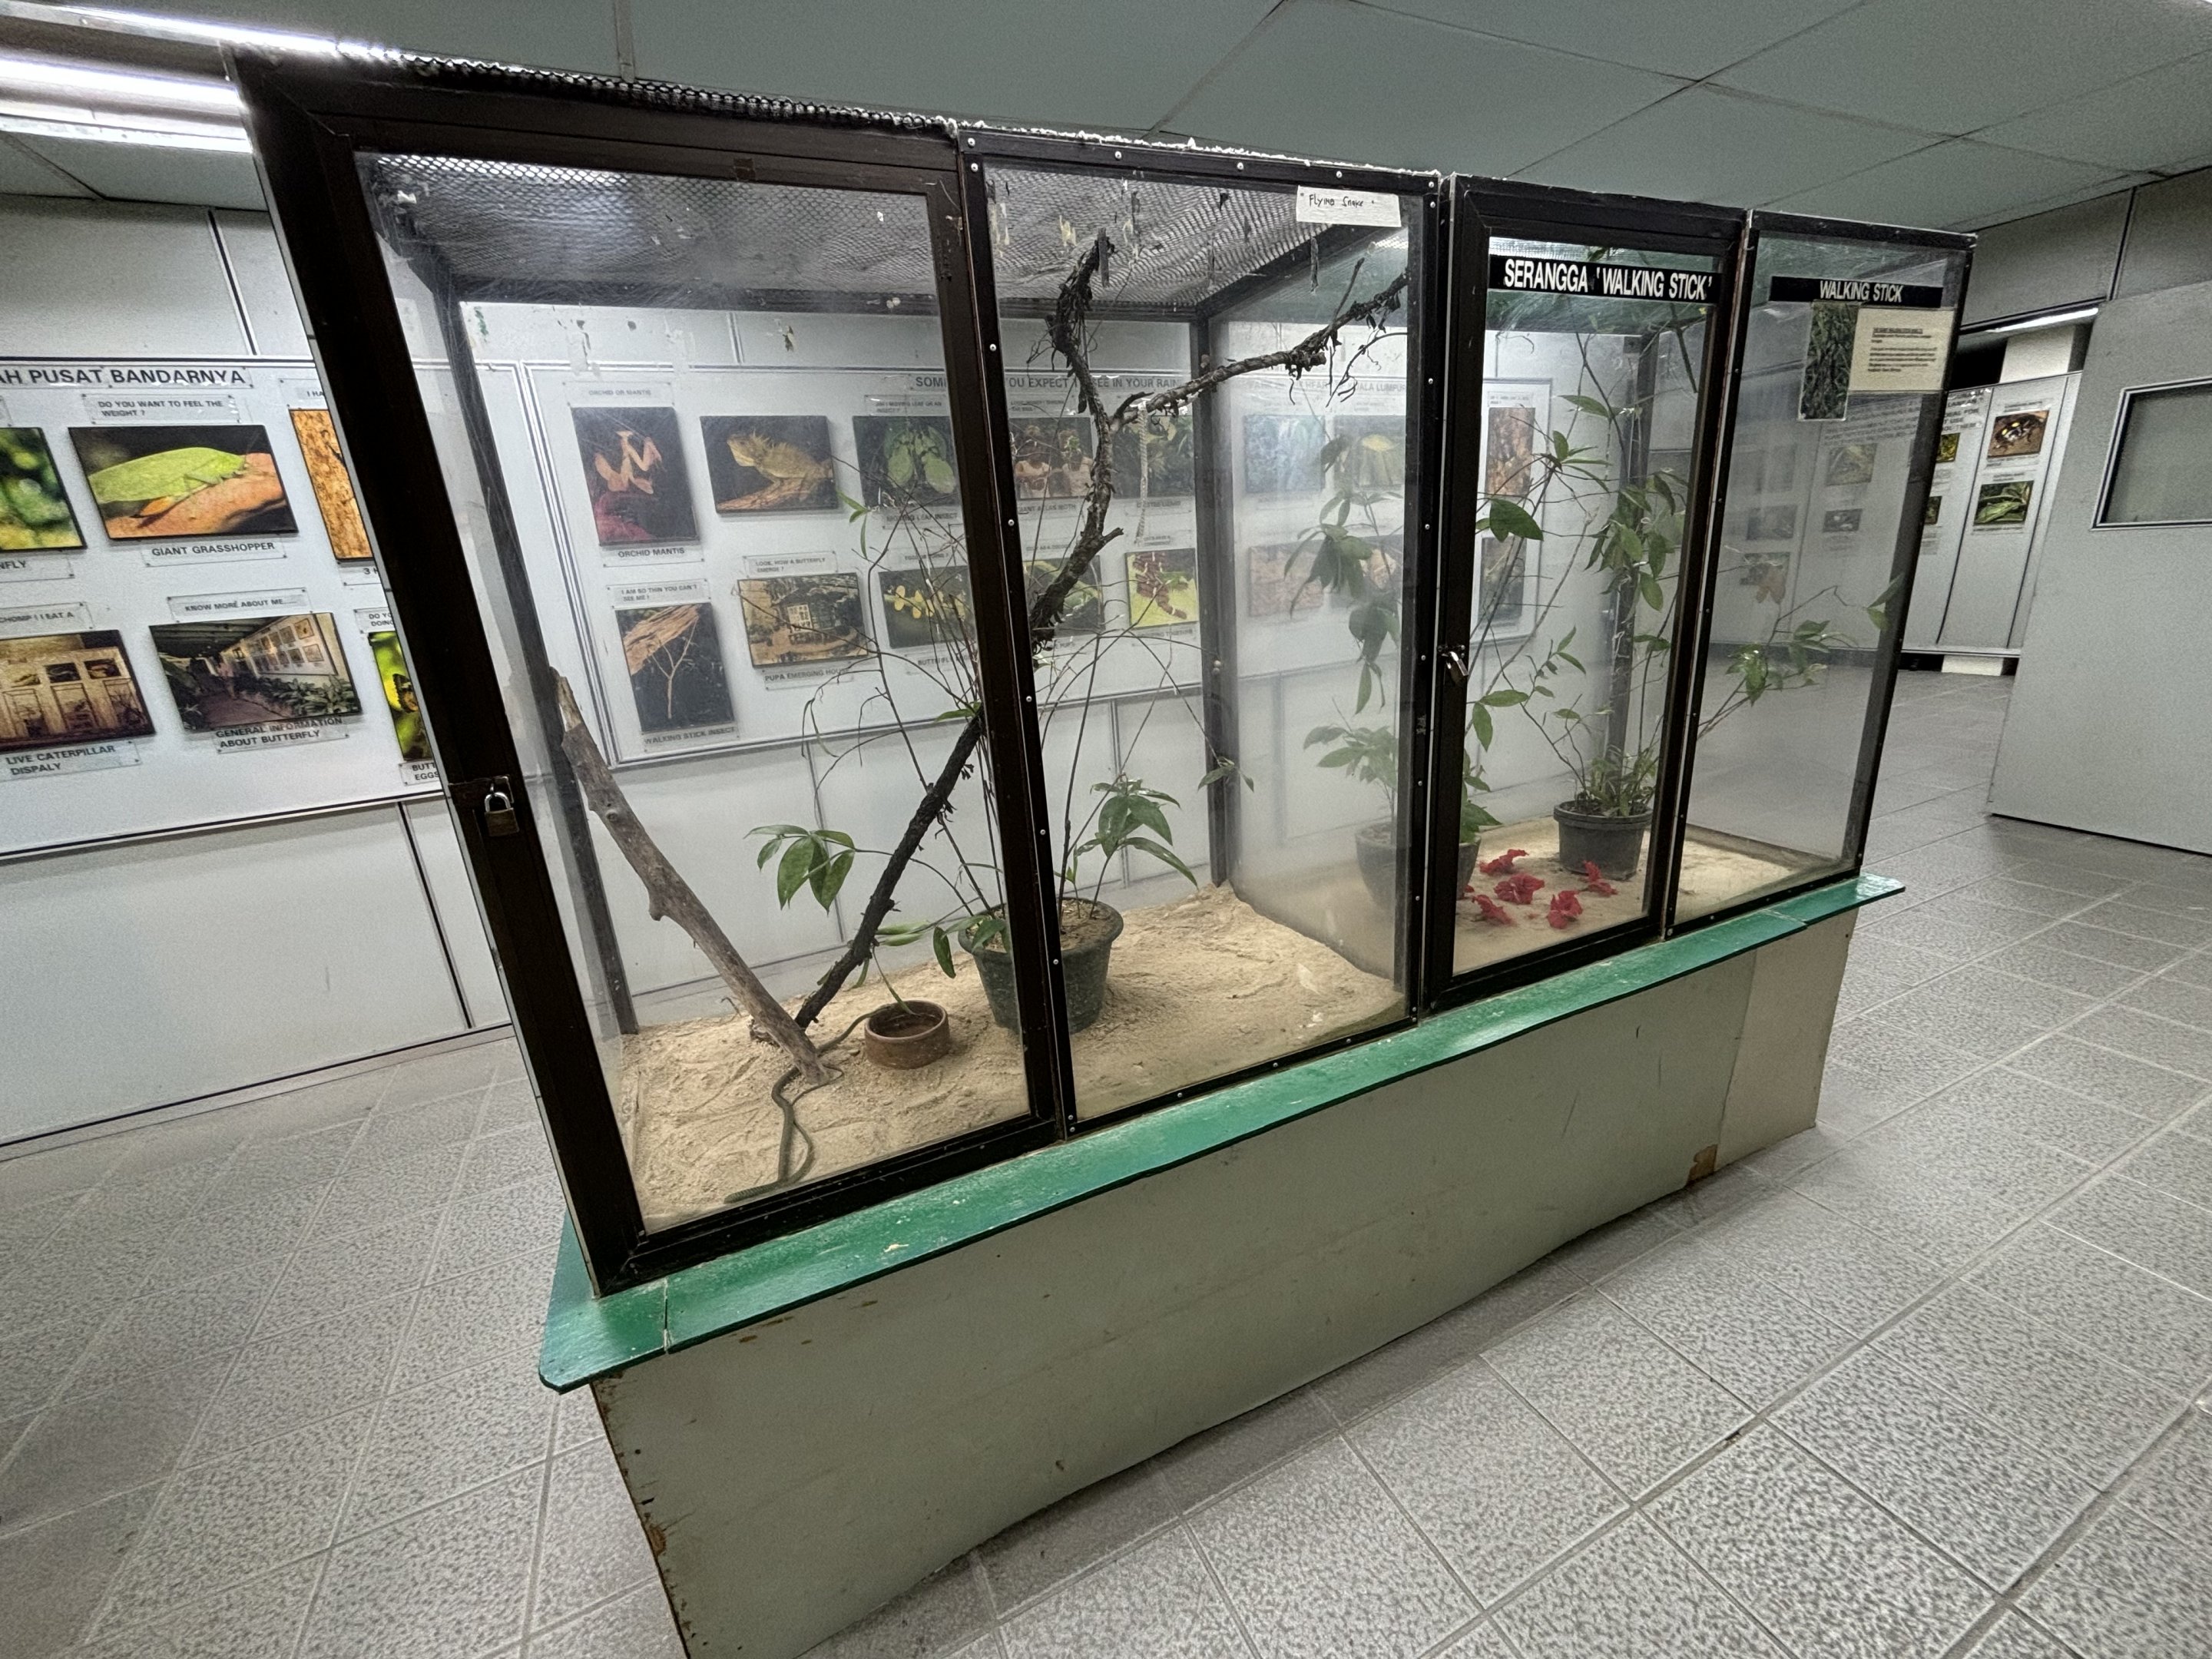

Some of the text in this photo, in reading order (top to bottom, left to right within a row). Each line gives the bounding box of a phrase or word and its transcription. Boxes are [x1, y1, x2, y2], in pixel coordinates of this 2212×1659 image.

[1504, 259, 1588, 293] SERANGGA
[1668, 272, 1713, 300] STICK'
[1820, 280, 1904, 303] WALKING STICK
[28, 369, 102, 383] PUSAT
[110, 369, 246, 383] BANDARNYA
[1028, 377, 1068, 388] EXPECT
[1125, 378, 1154, 388] YOUR
[151, 542, 275, 556] GIANT GRASSHOPPER
[618, 547, 685, 558] ORCHID MANTIS
[185, 603, 212, 612] KNOW
[765, 674, 786, 682] PUPA
[216, 717, 343, 738] GENERAL INFORMATION
[220, 730, 321, 748] ABOUT BUTTERFLY
[645, 726, 735, 744] WALKING STICK INSECT
[6, 745, 116, 765] LIVE CATERPILLAR
[10, 763, 61, 776] DISPALY
